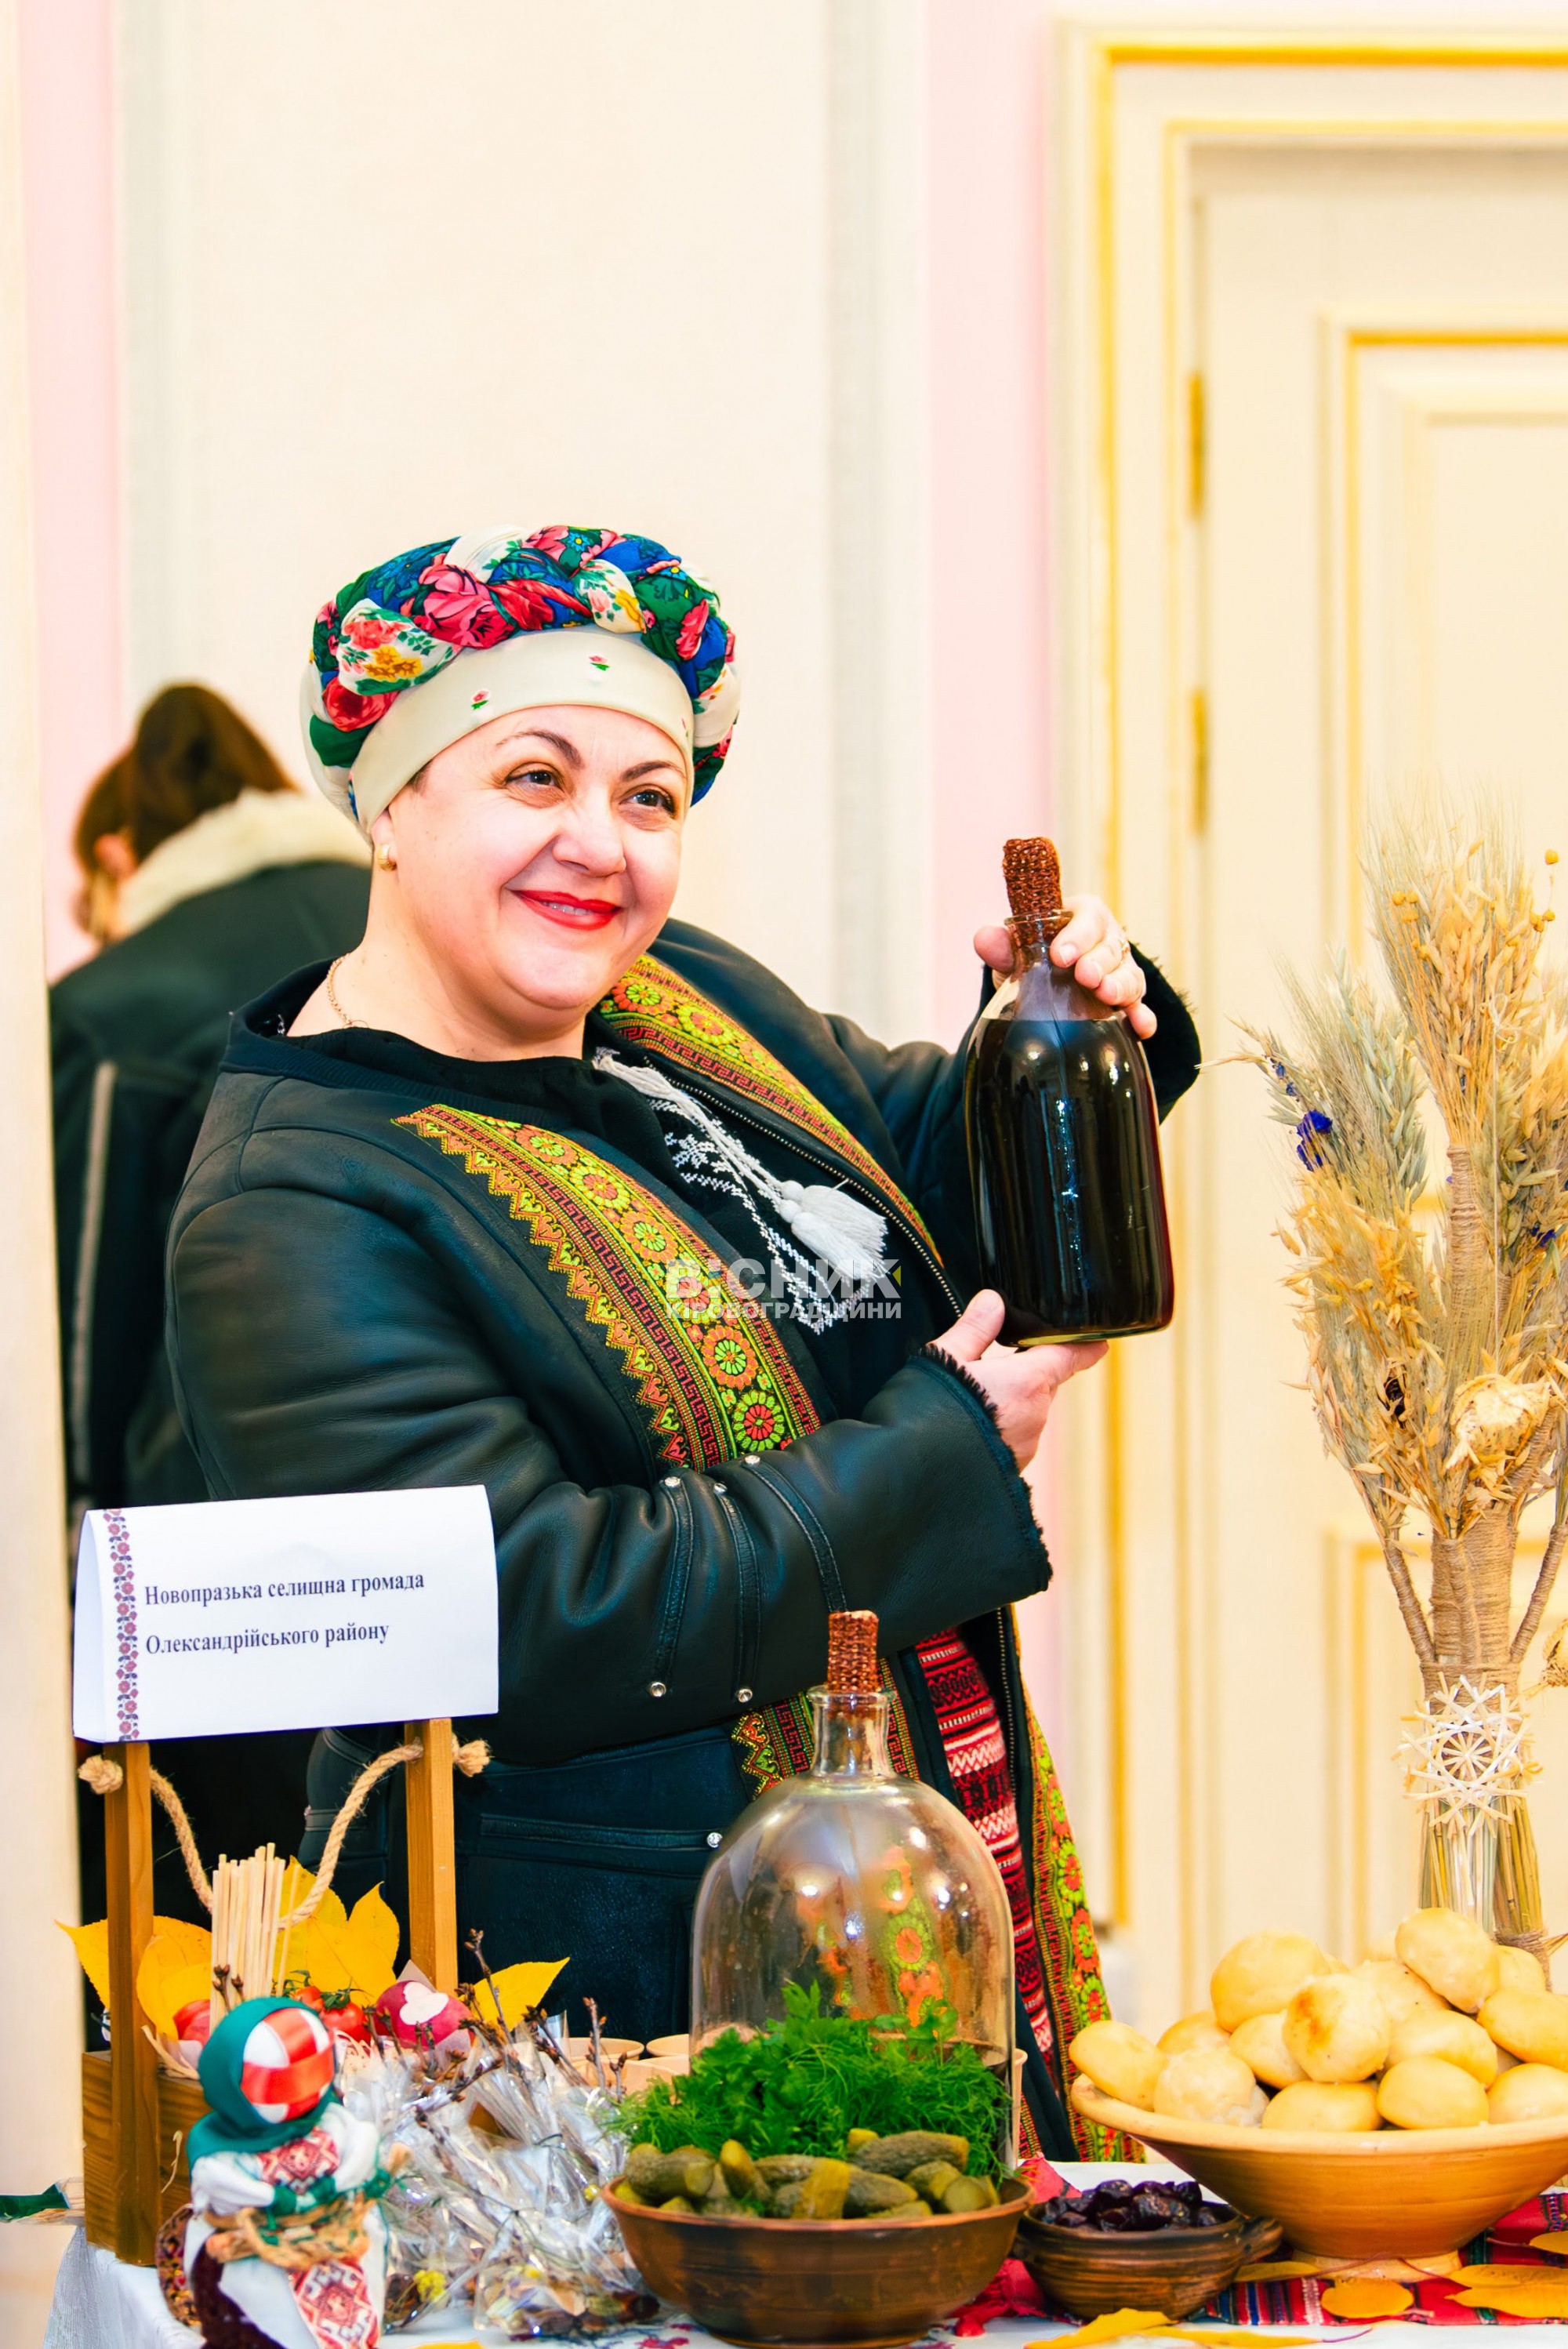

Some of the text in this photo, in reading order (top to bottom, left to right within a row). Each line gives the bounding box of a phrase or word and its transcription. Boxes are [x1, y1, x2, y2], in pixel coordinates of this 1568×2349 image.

[145, 1574, 425, 1607] Новопразька селищна громада
[146, 1622, 389, 1654] Олександрійського району
